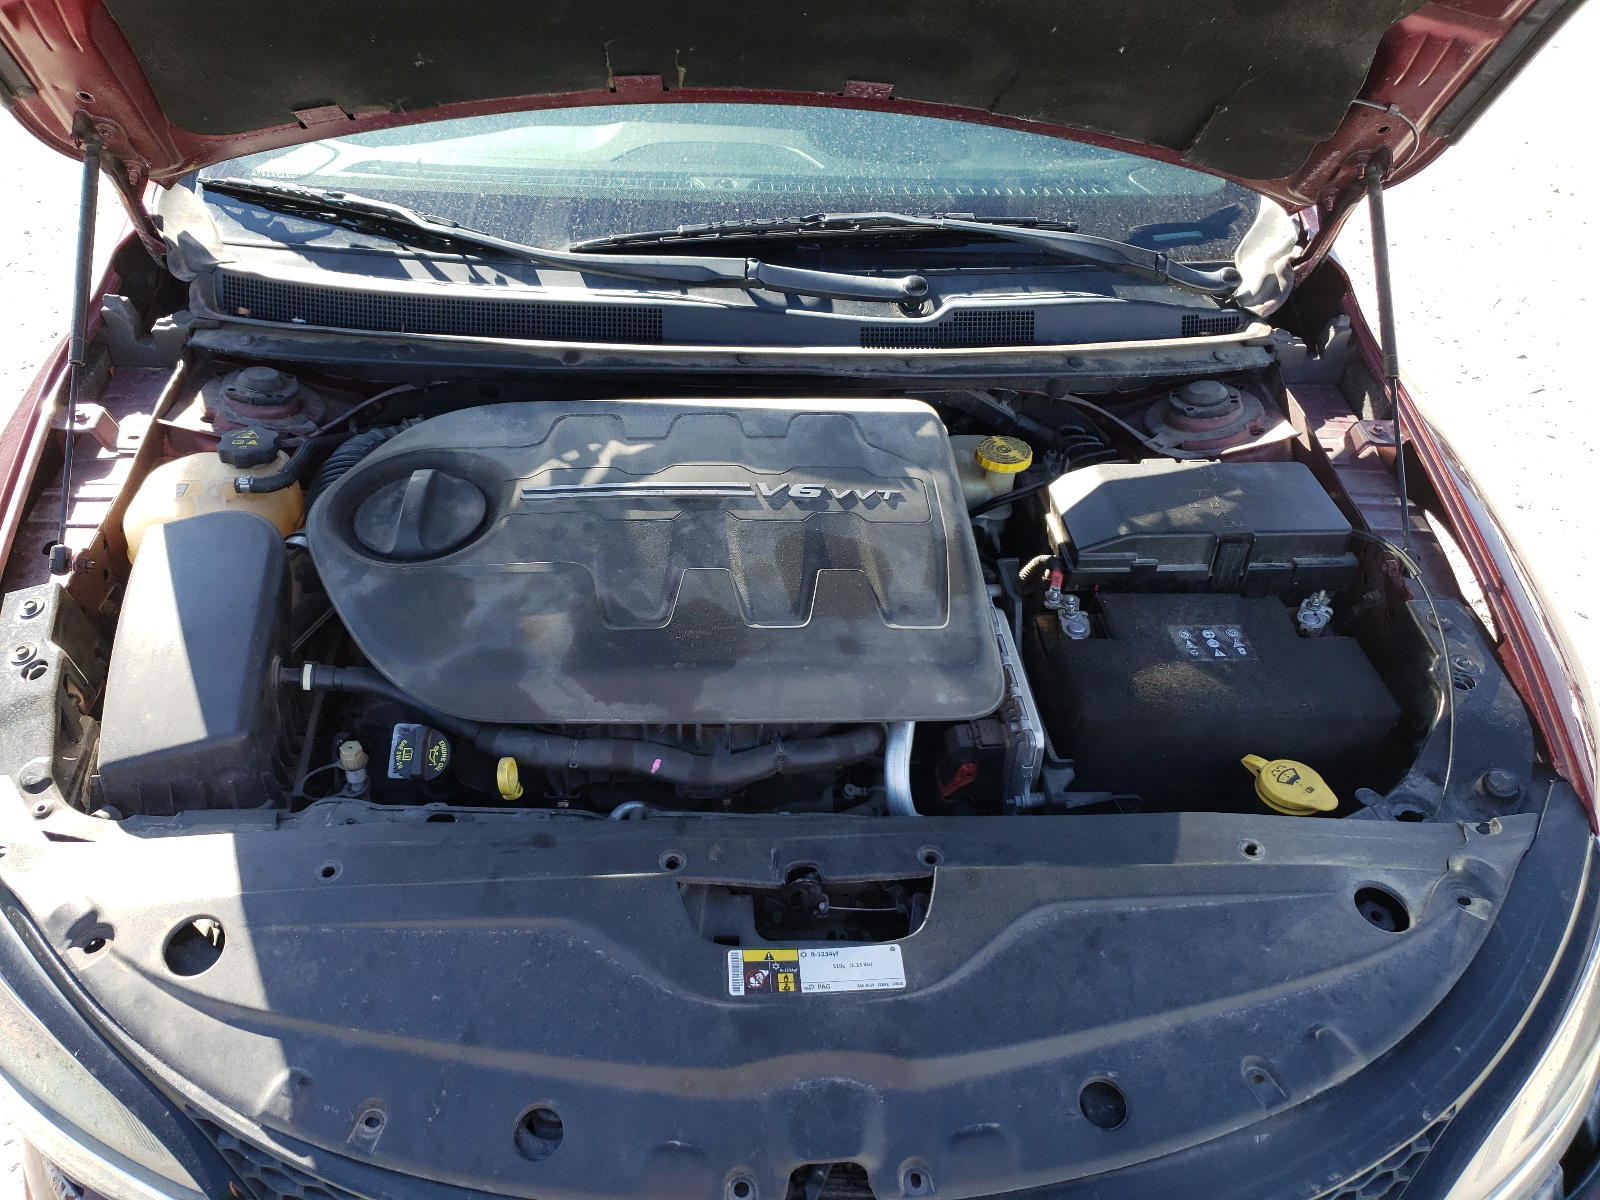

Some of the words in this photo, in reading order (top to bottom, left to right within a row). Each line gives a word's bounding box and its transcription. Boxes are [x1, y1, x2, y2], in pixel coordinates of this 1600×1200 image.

[756, 482, 826, 498] V6
[830, 489, 901, 500] VVT
[438, 740, 448, 762] ENGINE
[434, 762, 444, 771] OIL
